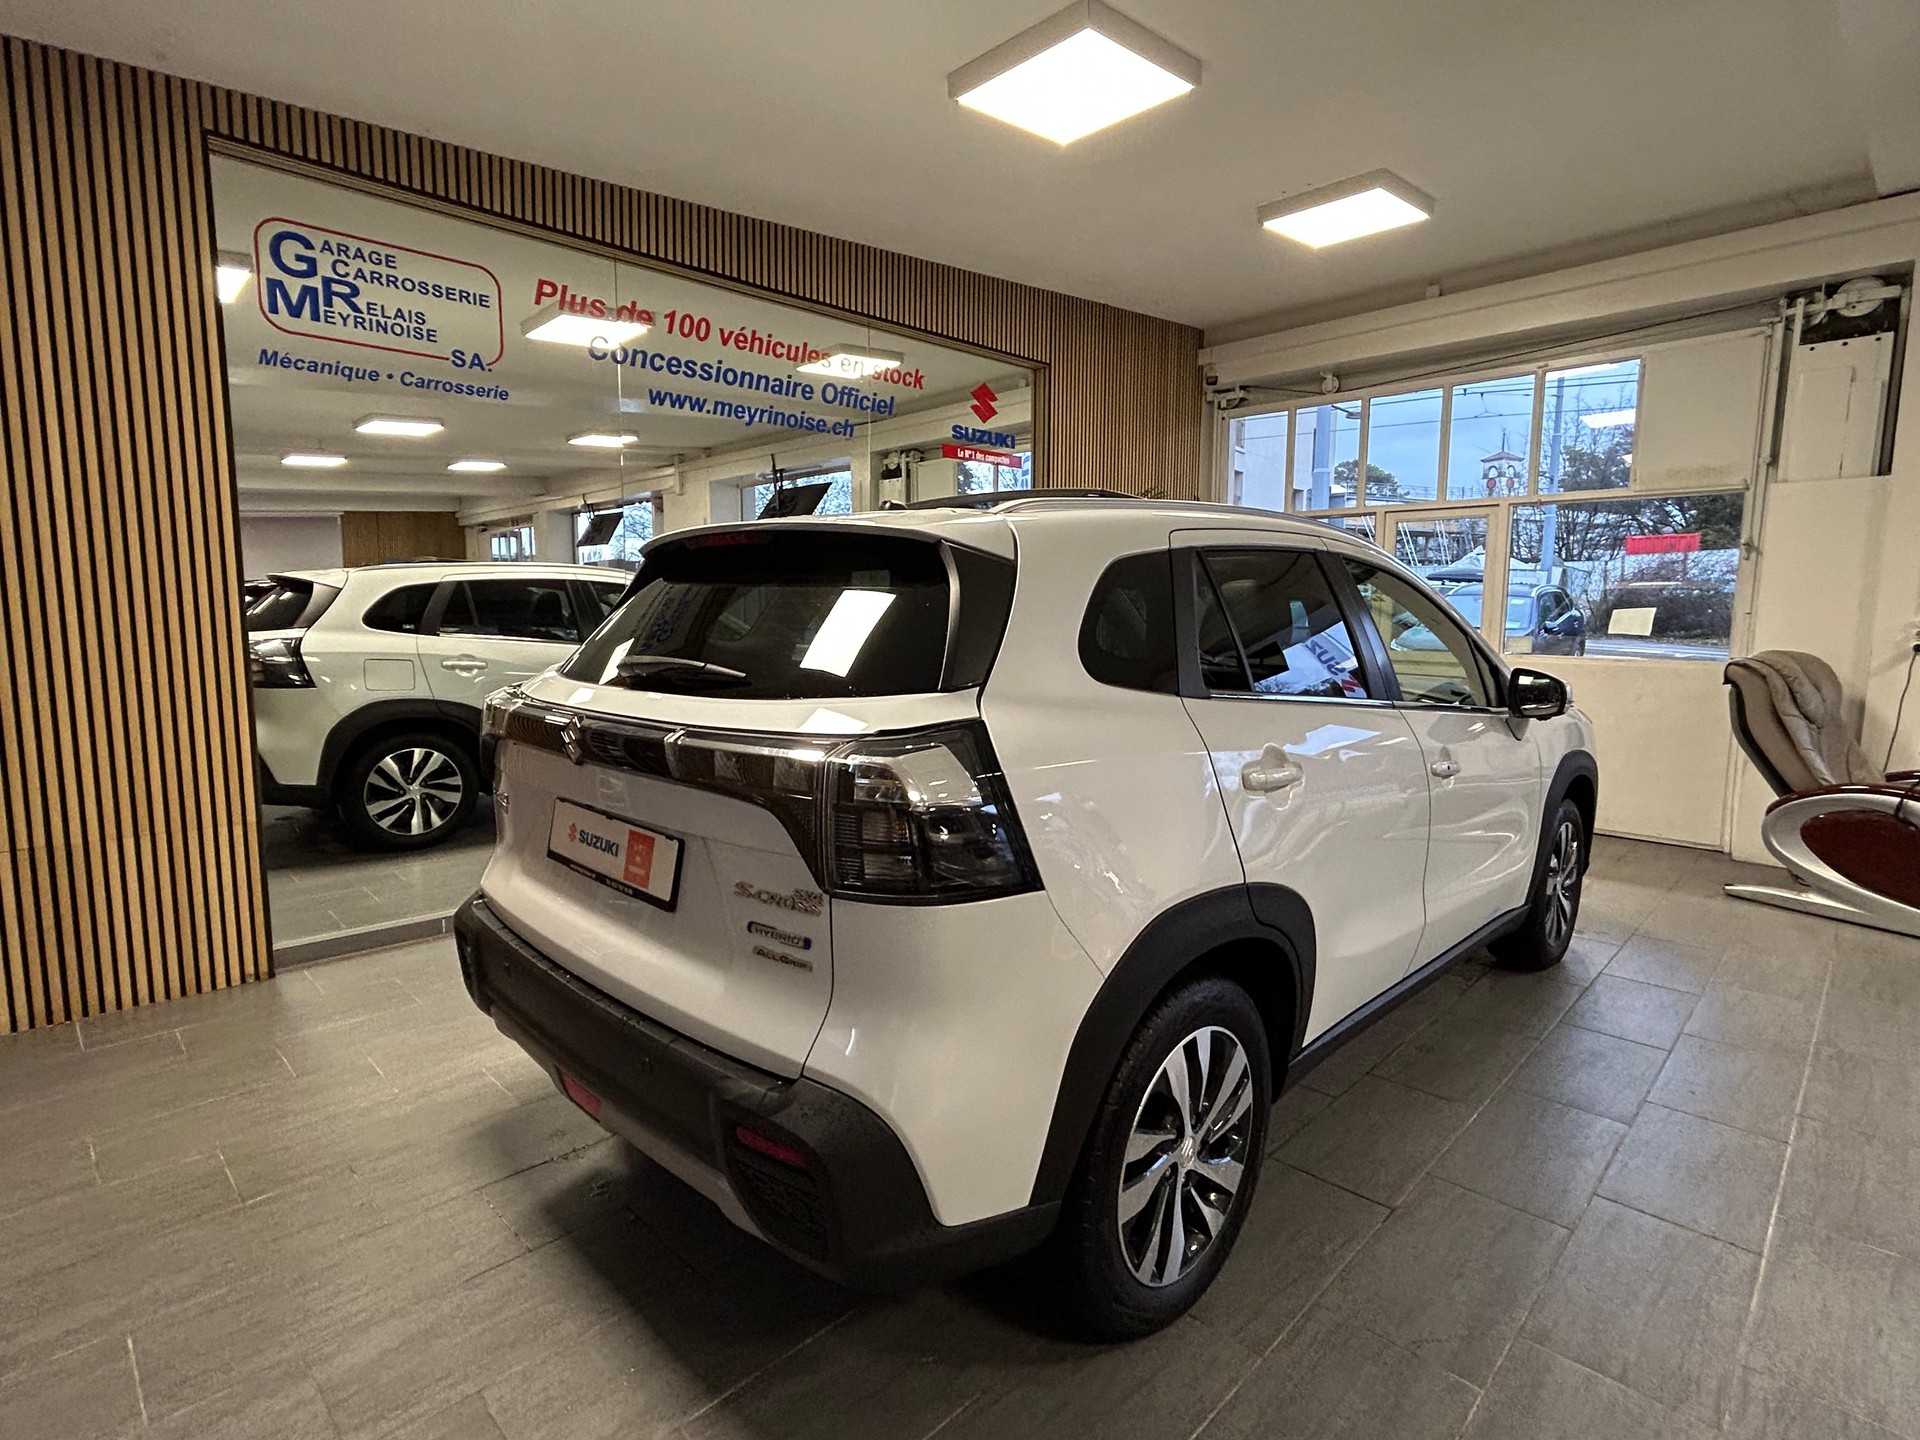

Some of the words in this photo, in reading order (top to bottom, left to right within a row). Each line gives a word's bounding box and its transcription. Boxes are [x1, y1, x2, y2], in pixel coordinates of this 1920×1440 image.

[269, 231, 397, 278] GARAGE
[322, 276, 427, 327] RELAIS
[331, 258, 490, 308] CARROSSERIE
[266, 278, 438, 343] MEYRINOISE
[534, 277, 607, 320] Plus
[617, 300, 654, 326] de
[664, 310, 712, 342] 100
[719, 327, 831, 368] véhicules
[840, 354, 865, 375] en
[871, 357, 925, 390] stock
[258, 348, 380, 382] Mécanique
[400, 371, 510, 401] Carrosserie
[451, 349, 493, 372] SA.
[588, 335, 815, 401] Concessionnaire
[821, 381, 895, 416] Officiel
[648, 386, 854, 438] www.meyrinoise.ch
[951, 423, 1016, 449] SUZUKI
[957, 448, 964, 457] Le
[975, 452, 985, 462] des
[577, 829, 619, 858] SUZUKI
[755, 926, 801, 945] HYBRID
